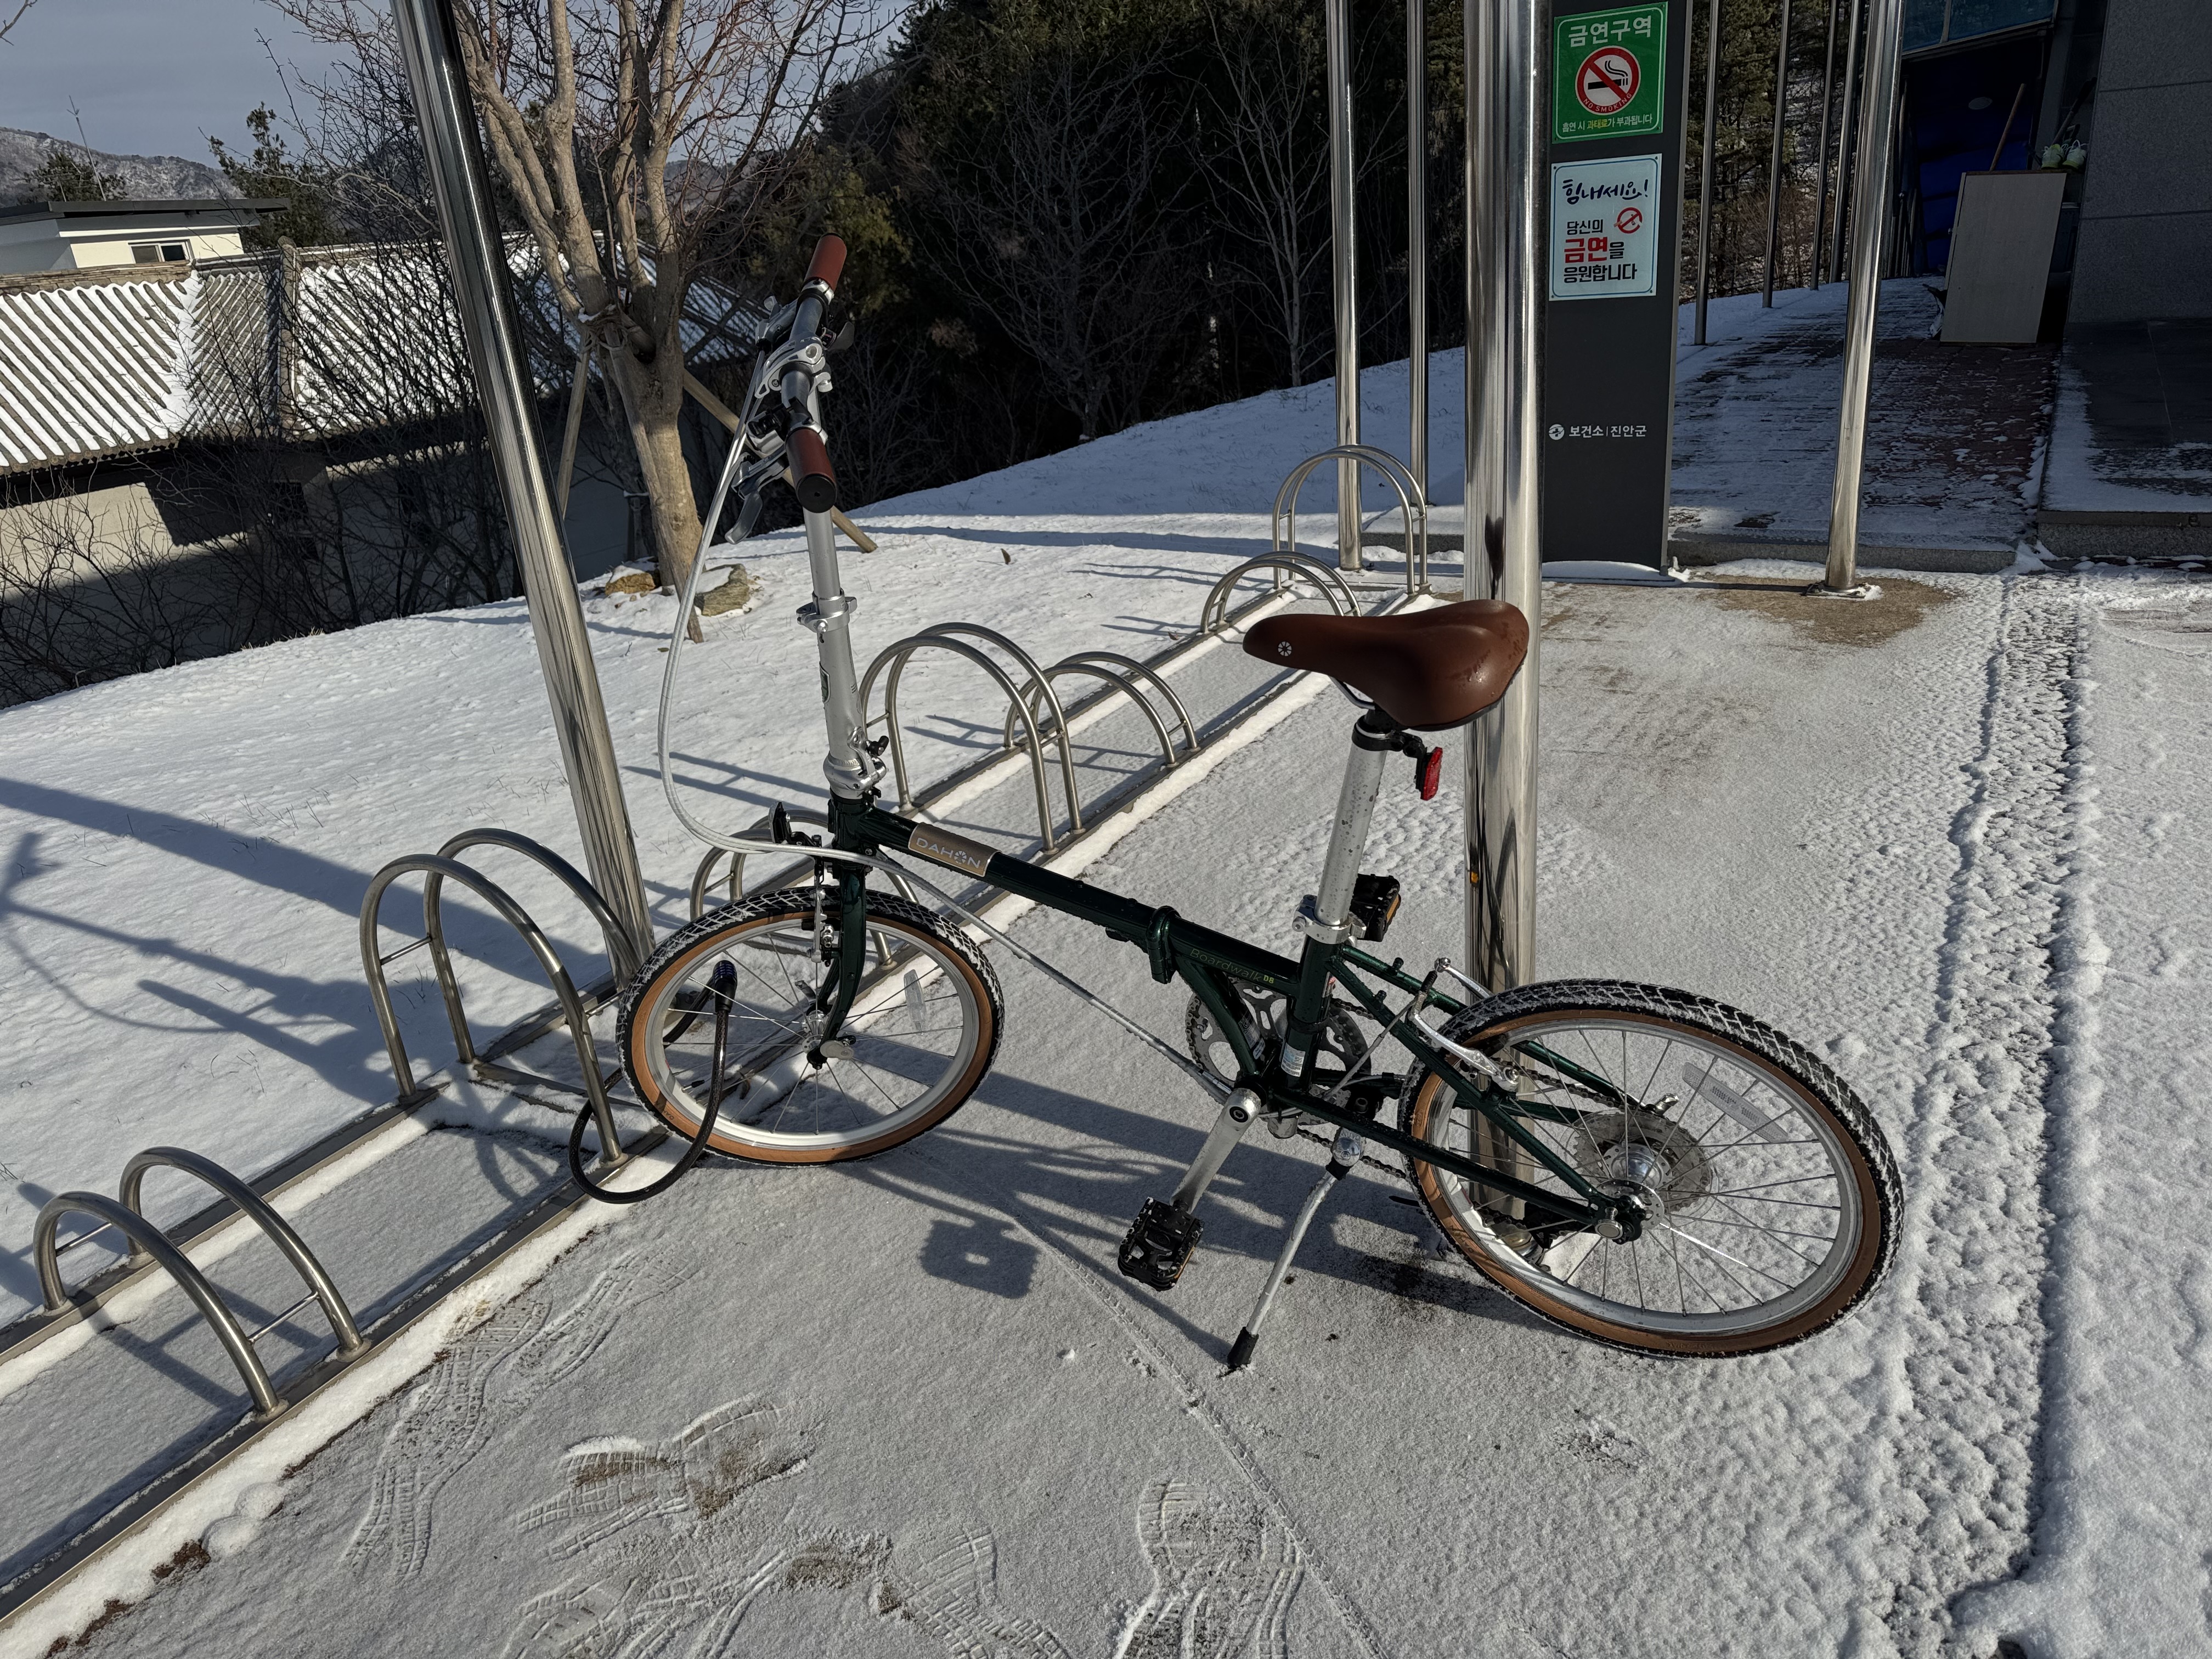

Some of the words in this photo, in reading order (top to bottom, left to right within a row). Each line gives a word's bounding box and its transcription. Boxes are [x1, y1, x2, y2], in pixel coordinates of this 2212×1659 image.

[1568, 15, 1651, 47] 금연구역
[1583, 98, 1593, 109] NO
[1595, 93, 1632, 112] SMOKING
[1562, 122, 1576, 132] 흡연
[1578, 121, 1585, 131] 시
[1587, 117, 1615, 130] 과태료가
[1616, 114, 1653, 127] 부과됩니다
[1562, 179, 1649, 205] 힘내세요!
[1567, 219, 1603, 235] 당신의
[1564, 236, 1625, 263] 금연을
[1564, 263, 1638, 284] 응원합니다
[1569, 426, 1604, 438] 보건소
[1610, 425, 1647, 437] 진안군
[916, 838, 981, 868] DAHON
[1189, 948, 1262, 982] Boardwalk
[1263, 975, 1274, 984] D8
